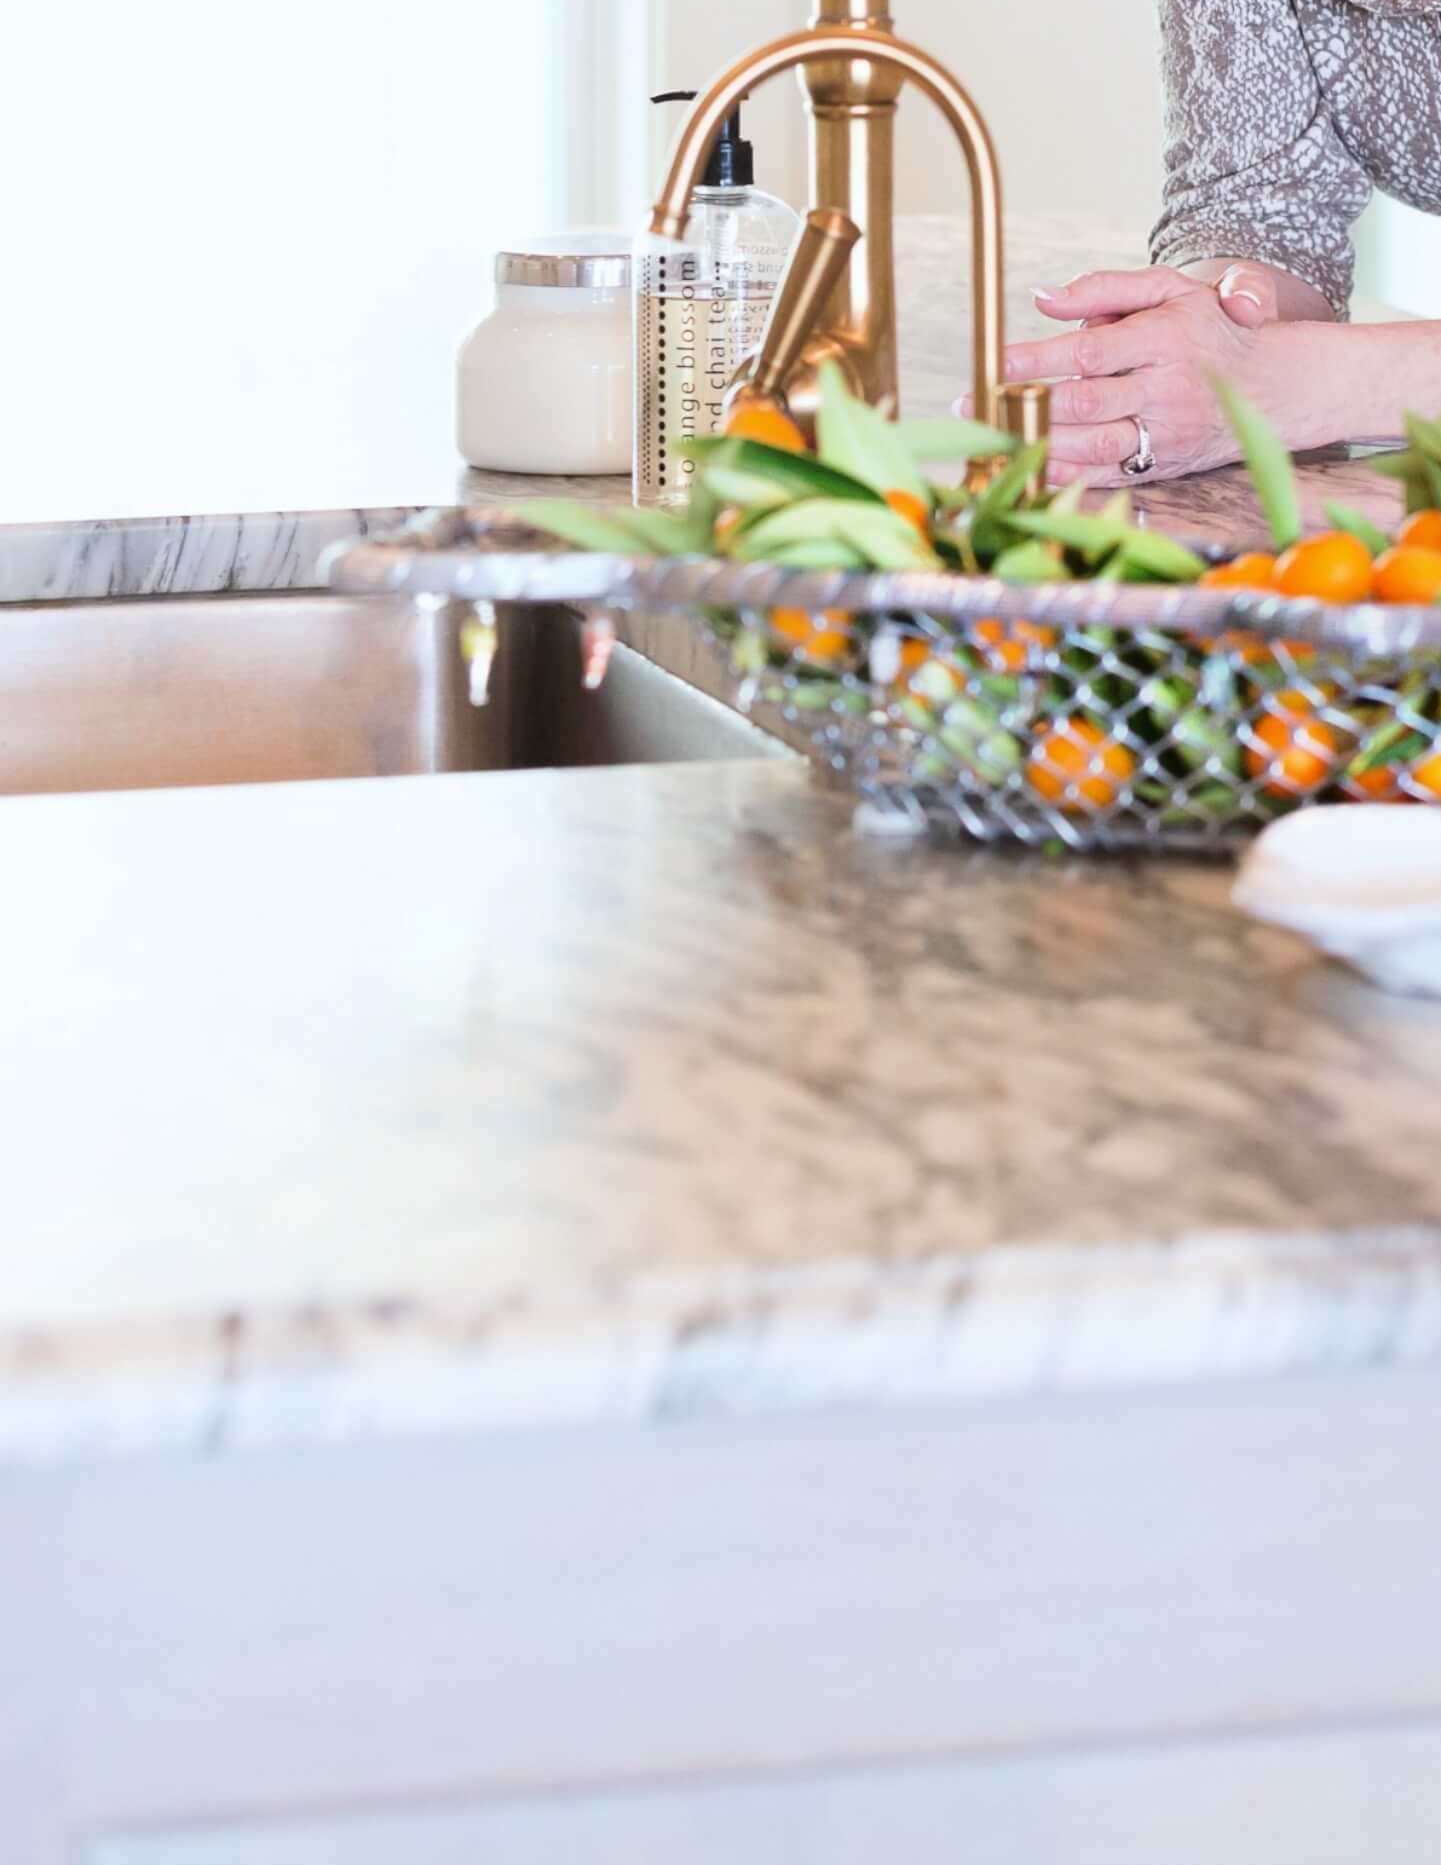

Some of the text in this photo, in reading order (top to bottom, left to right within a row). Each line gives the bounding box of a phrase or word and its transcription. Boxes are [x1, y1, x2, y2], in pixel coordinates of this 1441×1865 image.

[708, 284, 726, 325] tea
[676, 258, 701, 474] oange blossom
[705, 335, 726, 389] chai
